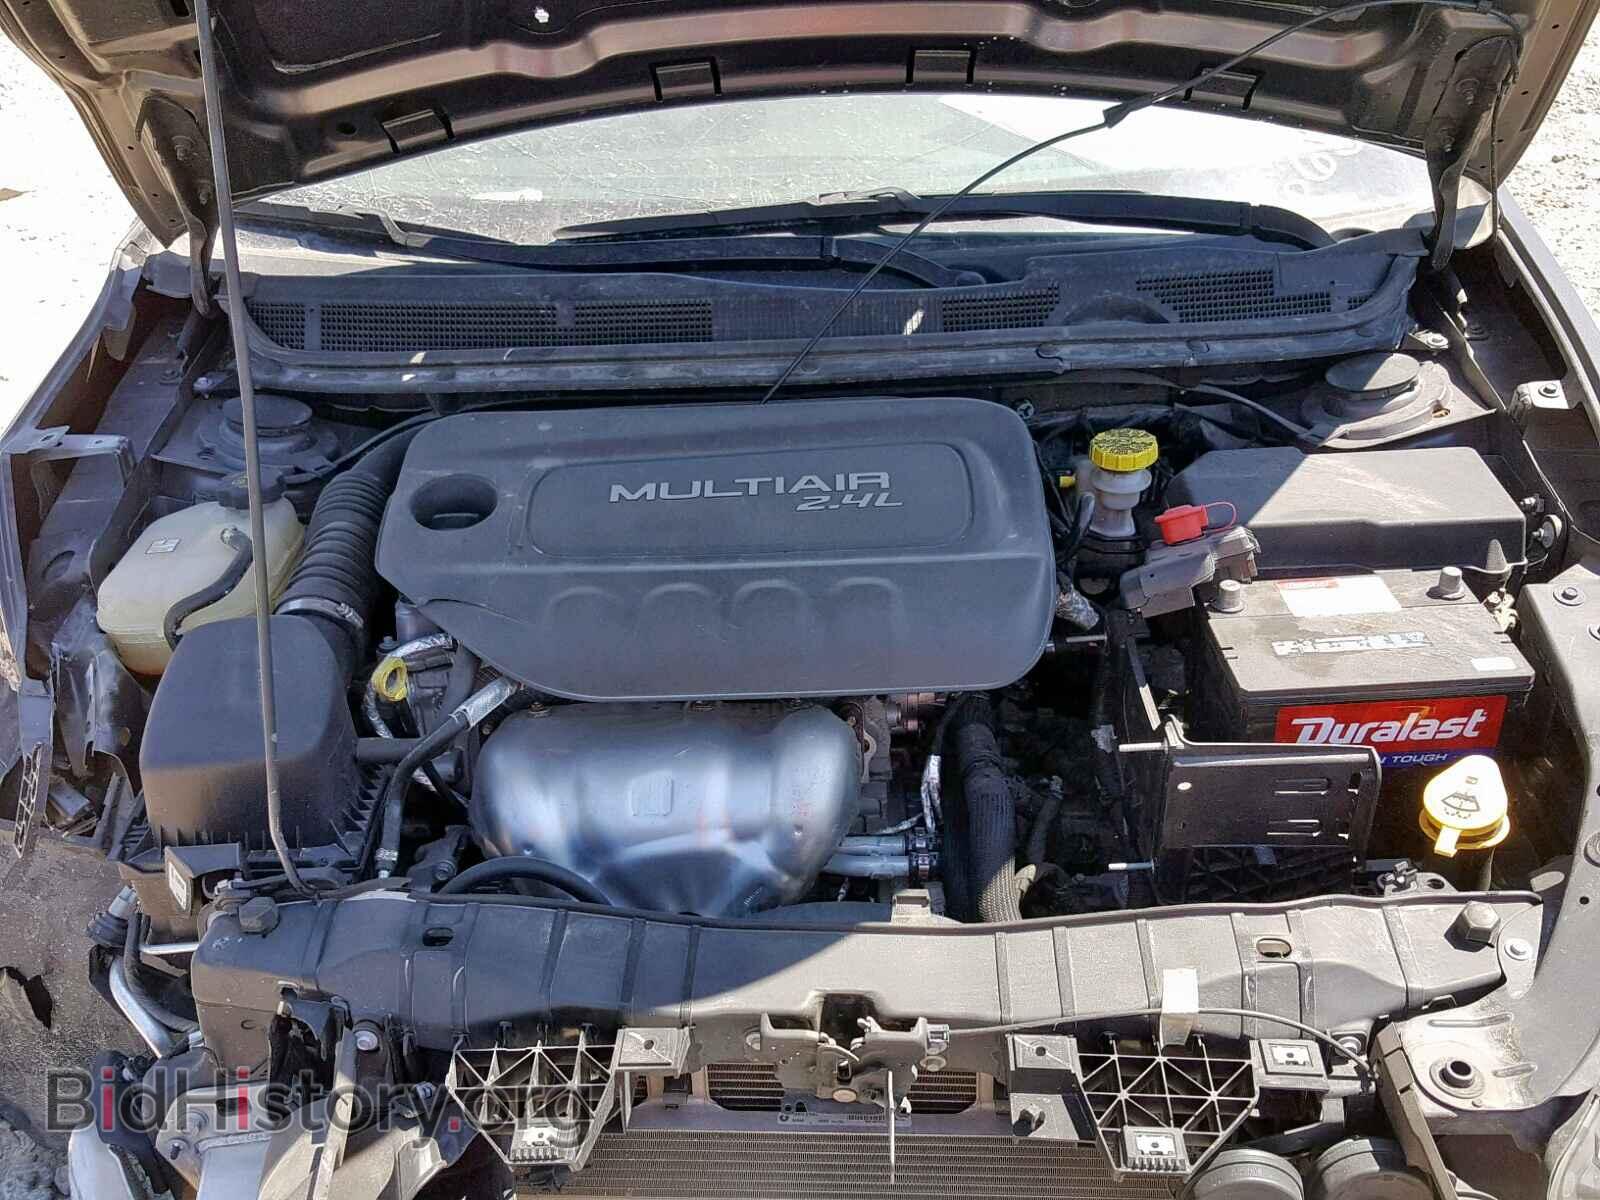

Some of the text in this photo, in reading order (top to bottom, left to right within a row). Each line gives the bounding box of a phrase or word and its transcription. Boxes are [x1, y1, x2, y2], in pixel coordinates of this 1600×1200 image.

[609, 471, 891, 503] MULTIAIR
[796, 492, 904, 512] 2.4L
[1291, 708, 1487, 745] Duralast
[1391, 753, 1448, 764] TOUGH
